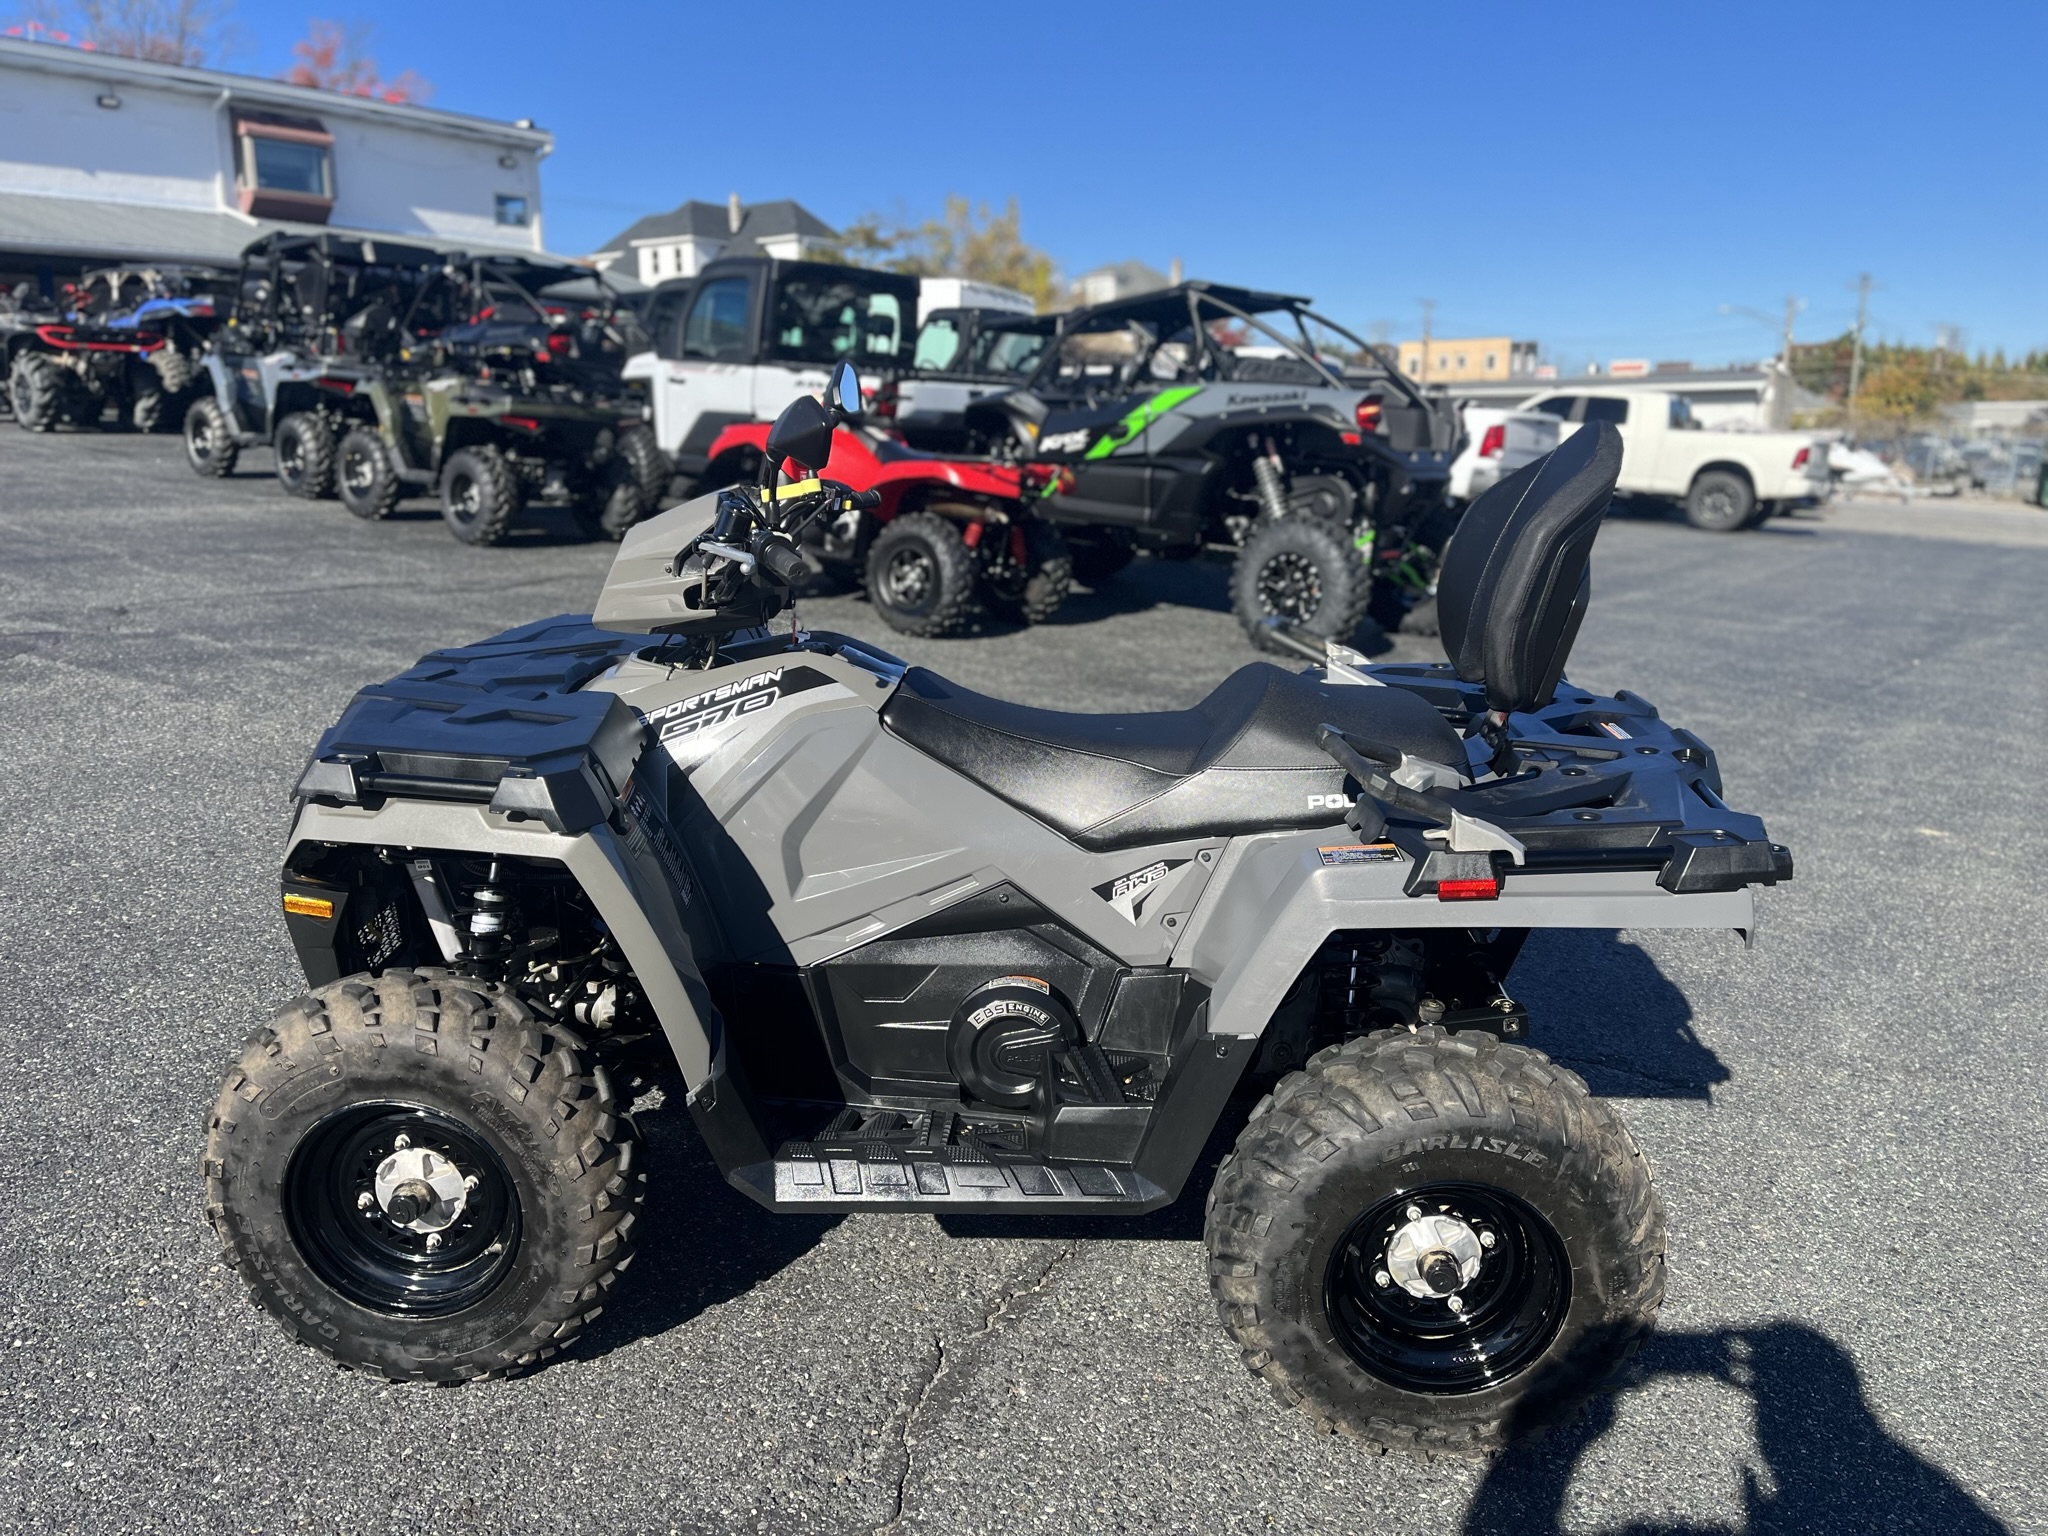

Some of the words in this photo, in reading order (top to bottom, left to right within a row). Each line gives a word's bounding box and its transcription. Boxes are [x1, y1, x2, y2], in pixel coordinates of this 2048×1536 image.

[1227, 389, 1308, 406] Kawasaki
[637, 666, 783, 726] SPORTSMAN
[656, 686, 780, 747] 570
[1112, 865, 1169, 900] AWD
[973, 1004, 1005, 1025] EBS
[1008, 1003, 1047, 1021] ENGINE
[1380, 1134, 1549, 1169] CARLISLE
[235, 1215, 341, 1341] CARLISLE
